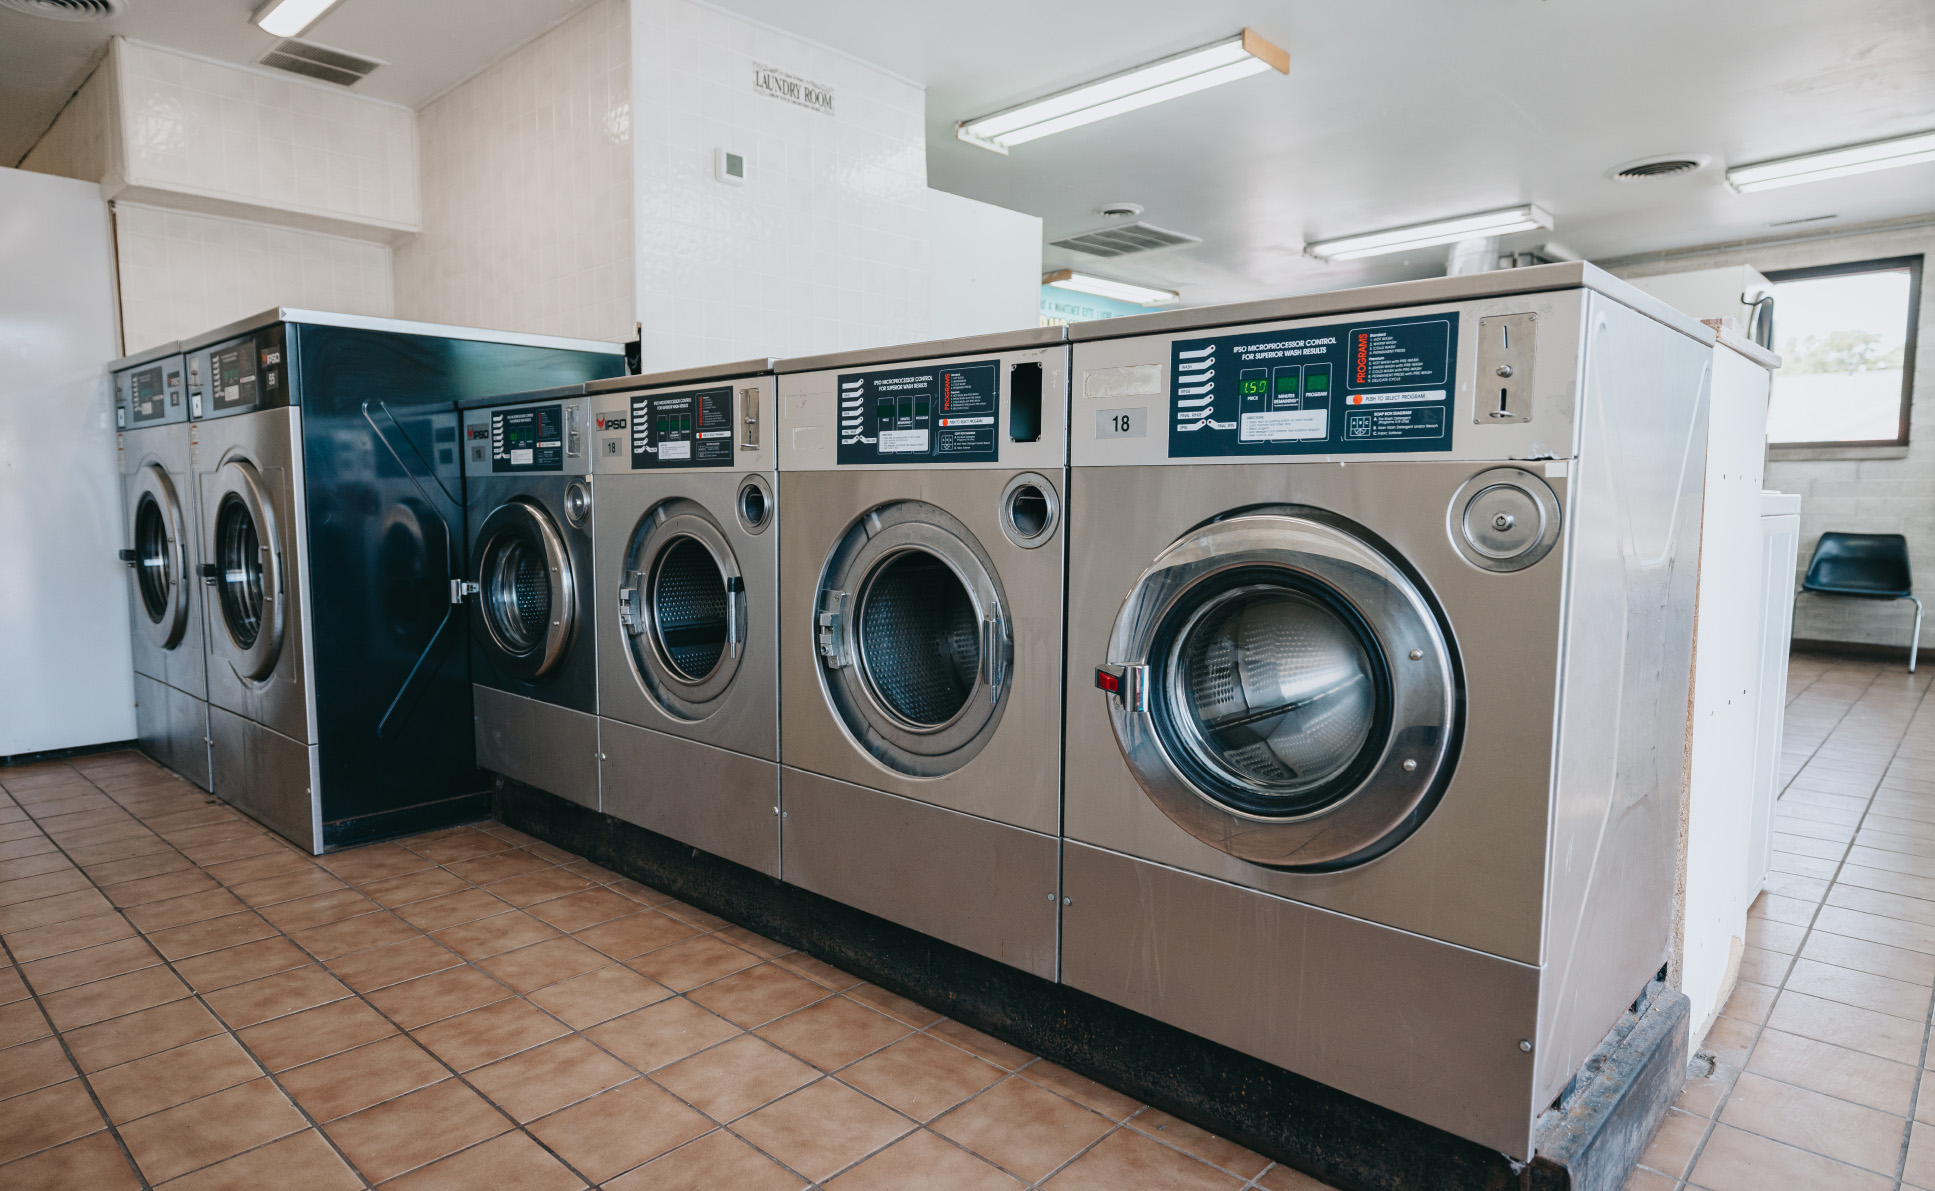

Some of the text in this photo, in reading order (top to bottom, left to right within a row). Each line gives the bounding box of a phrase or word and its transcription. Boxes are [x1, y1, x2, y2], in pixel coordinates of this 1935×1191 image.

[756, 70, 801, 100] LAUNDRY
[805, 86, 832, 110] ROOM
[1247, 340, 1304, 352] MICROPROCESSOR
[1305, 337, 1337, 346] CONTROL
[1242, 347, 1327, 361] FOR SUPERIOR WASH RESULTS
[1356, 333, 1368, 383] PROGRAMS
[605, 419, 627, 430] IPSO
[1112, 415, 1130, 432] 18
[608, 442, 615, 453] 18
